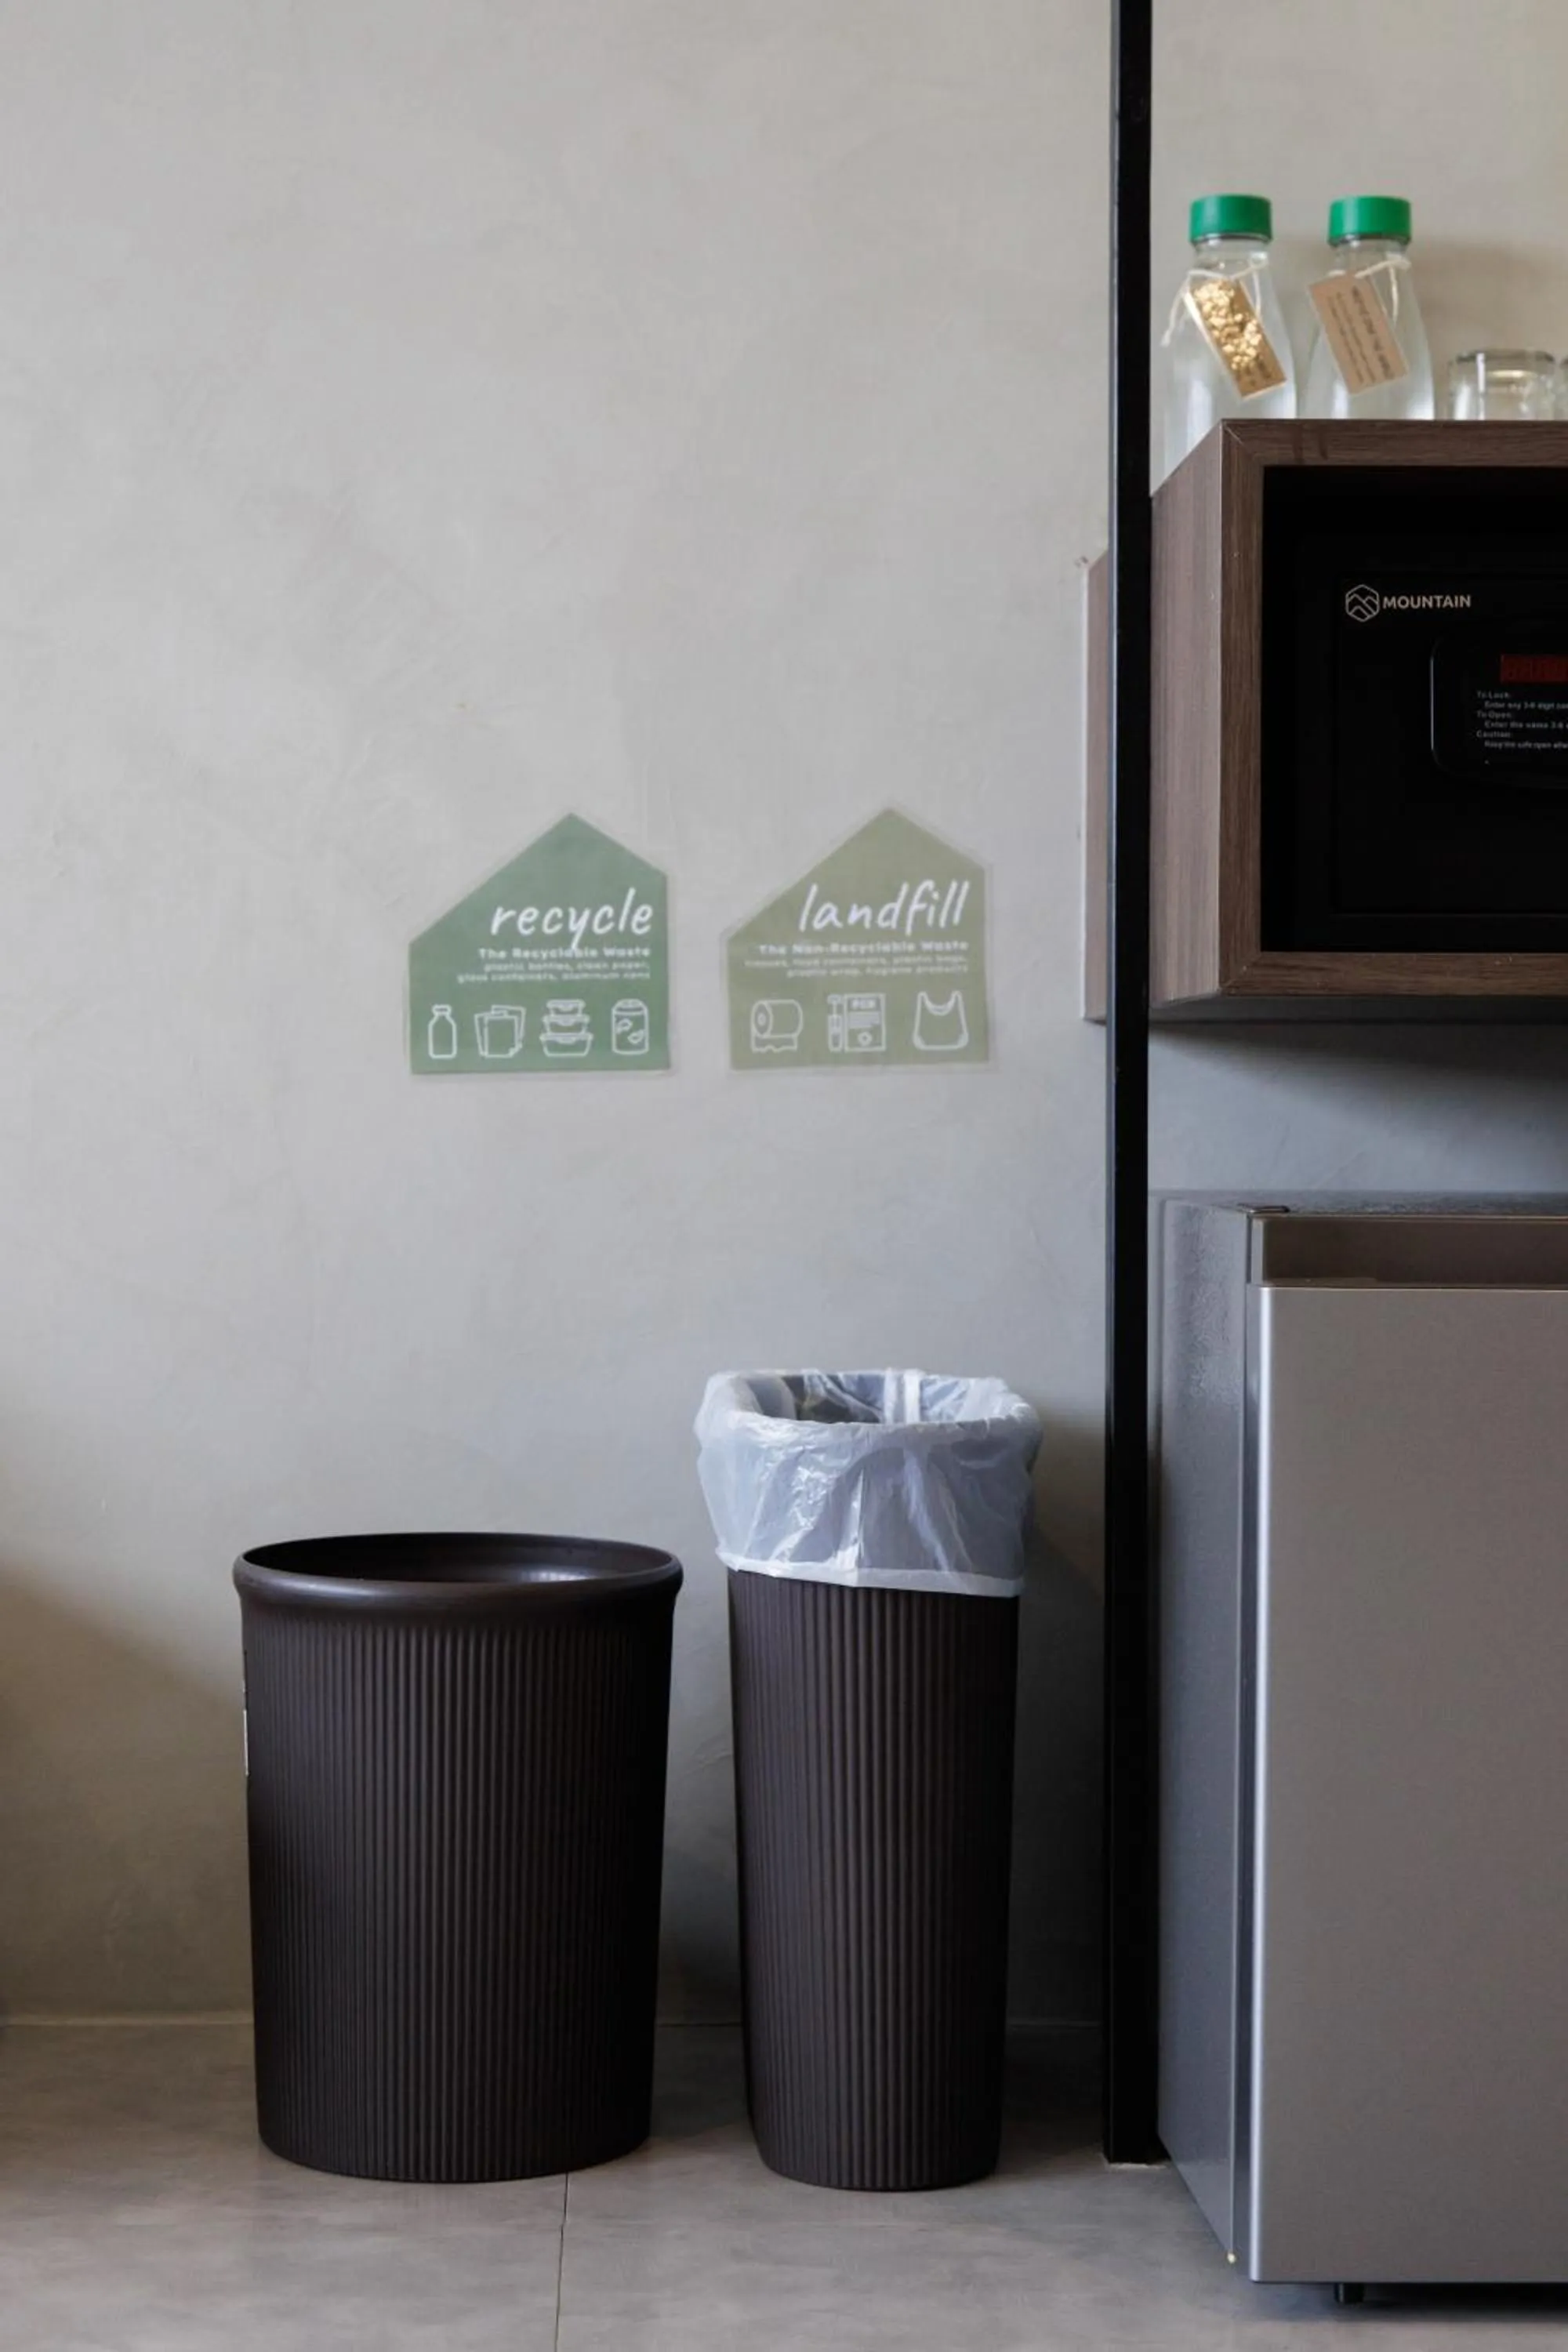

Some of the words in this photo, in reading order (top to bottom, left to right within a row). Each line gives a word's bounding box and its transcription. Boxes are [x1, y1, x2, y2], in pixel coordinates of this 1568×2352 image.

[1382, 594, 1472, 609] MOUNTAIN
[798, 879, 970, 936] landfill
[491, 887, 654, 950] recycle
[477, 947, 507, 960] The
[603, 946, 651, 957] Waste
[759, 943, 787, 955] The
[920, 940, 969, 952] Waste
